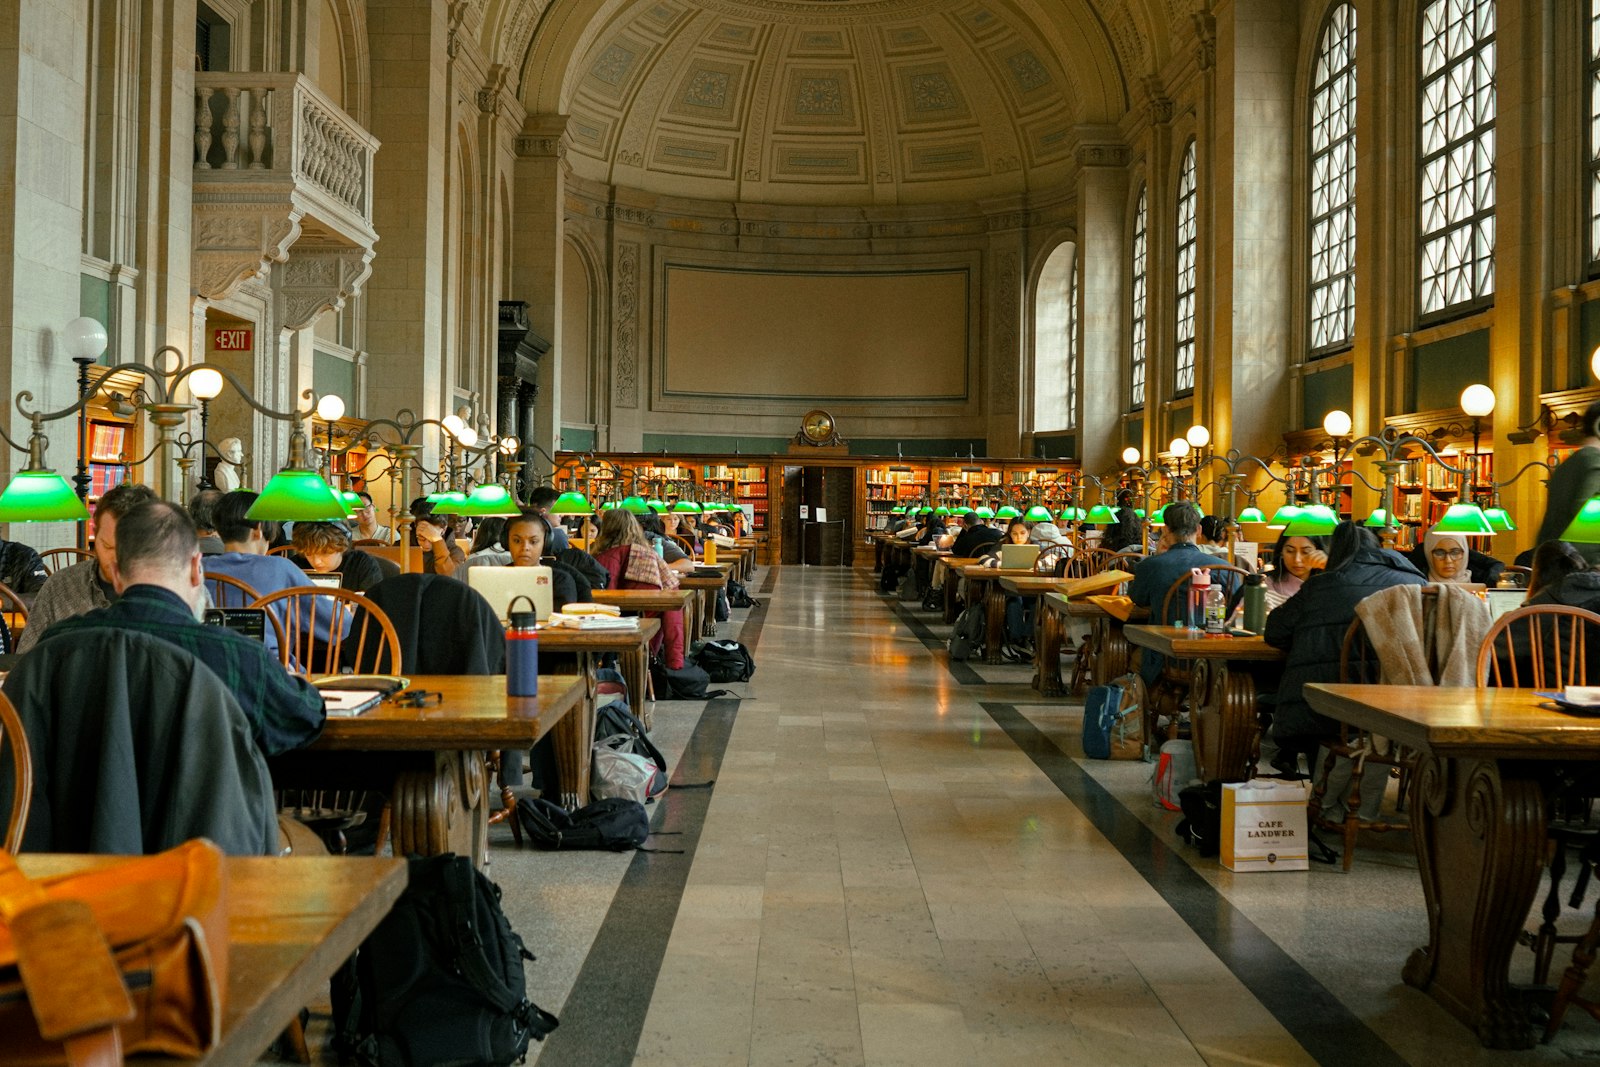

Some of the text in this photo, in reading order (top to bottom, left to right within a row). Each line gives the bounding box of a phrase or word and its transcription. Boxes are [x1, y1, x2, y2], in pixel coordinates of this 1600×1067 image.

[221, 331, 246, 348] EXIT
[1258, 820, 1283, 828] CAFE
[1248, 830, 1295, 838] LANDWER
